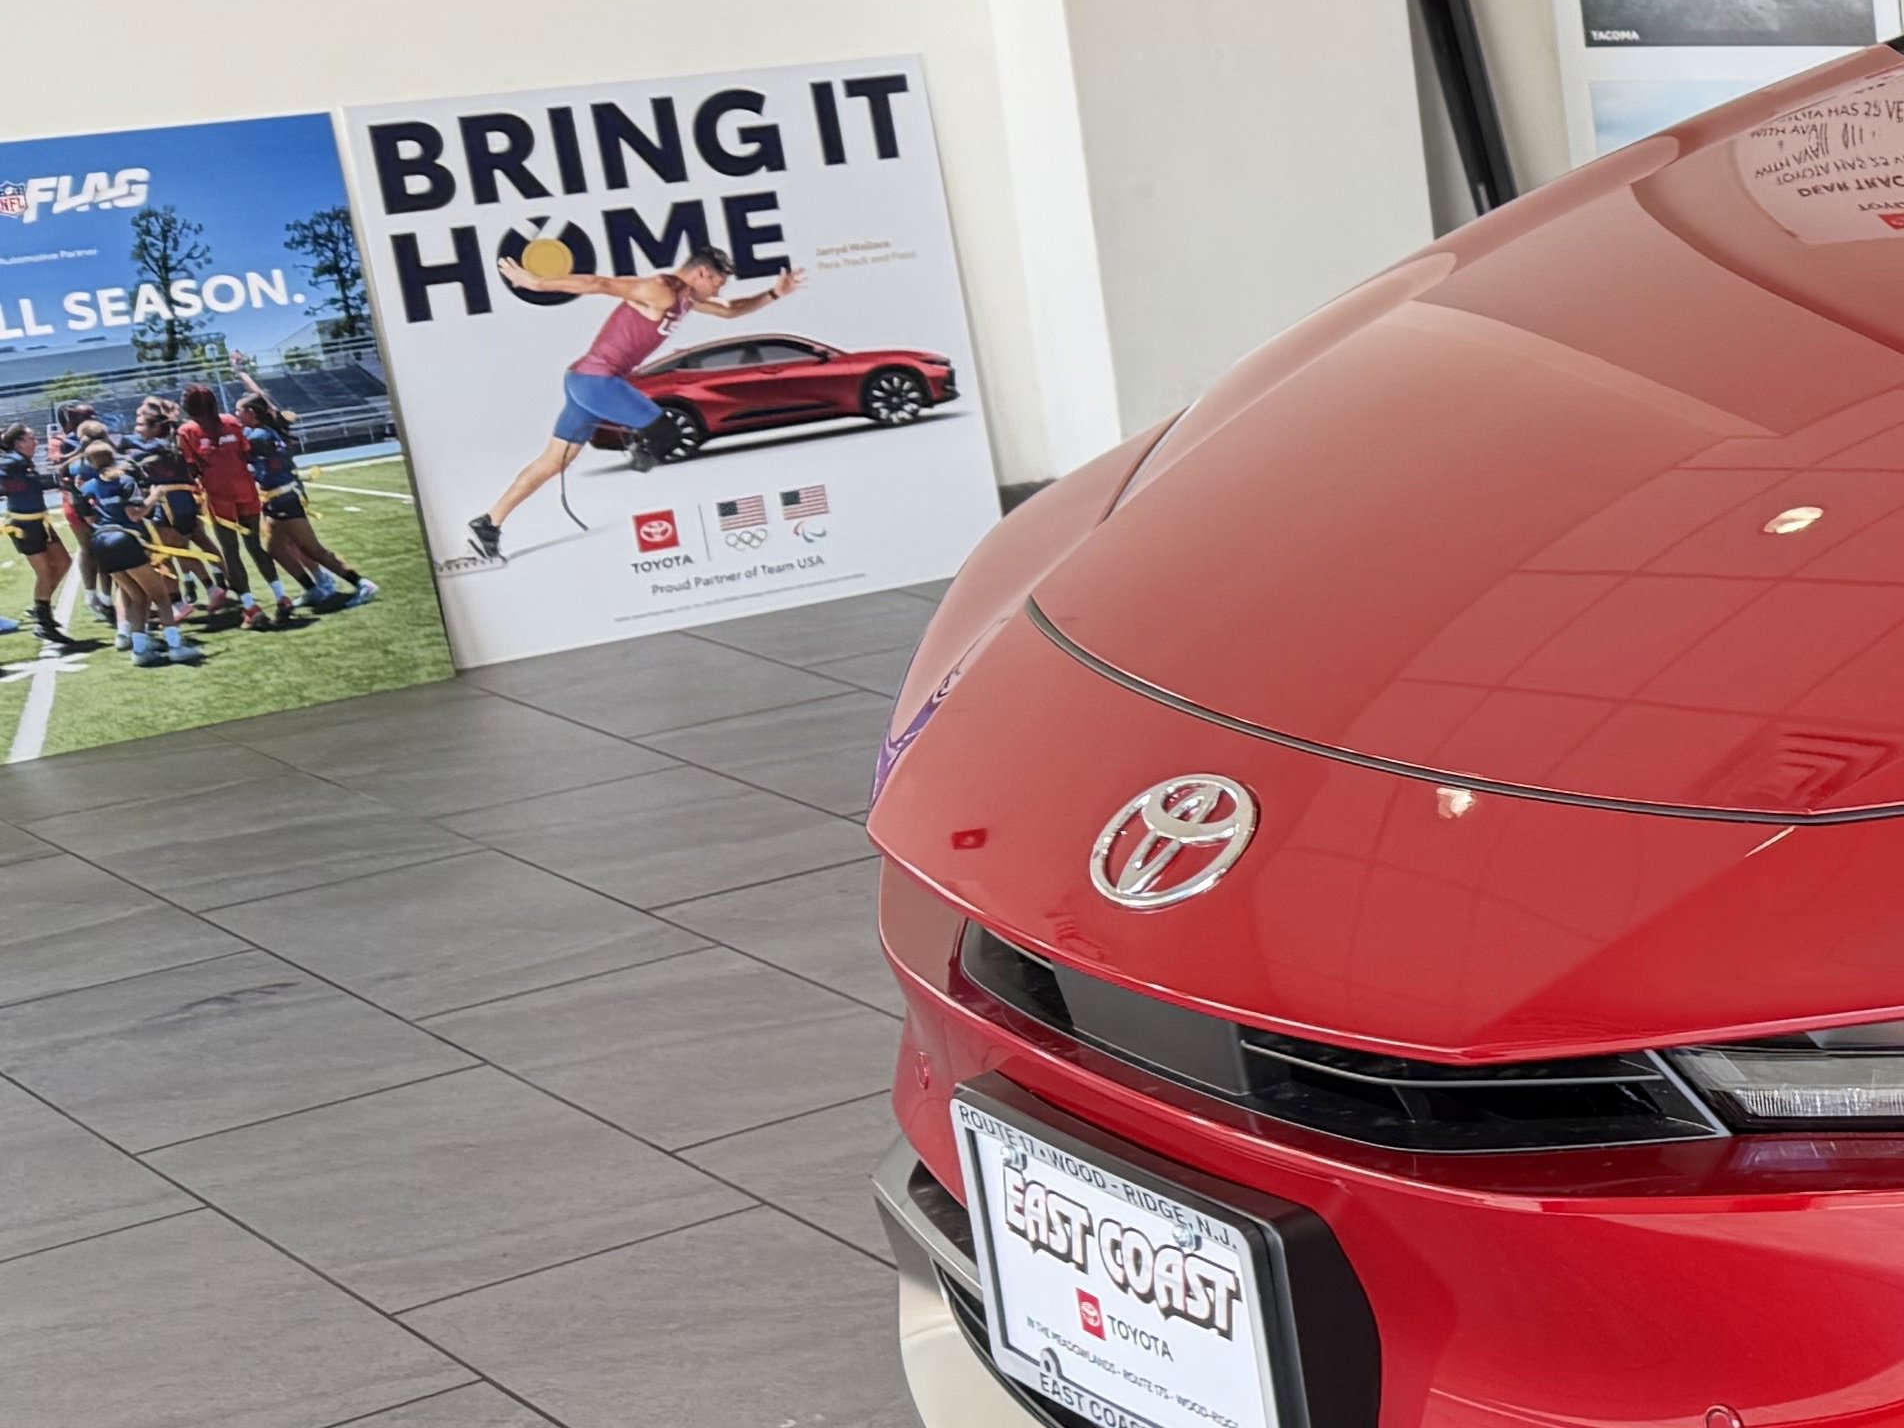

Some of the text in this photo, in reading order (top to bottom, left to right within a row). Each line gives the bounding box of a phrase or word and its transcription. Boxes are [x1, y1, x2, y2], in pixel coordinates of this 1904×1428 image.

[366, 73, 909, 217] BRING IT
[23, 167, 150, 223] FLAG
[389, 191, 792, 324] HOME
[63, 269, 306, 331] SEASON.
[631, 554, 695, 575] TOYOTA
[651, 554, 826, 596] Proud Partner of Team USA
[959, 1105, 1016, 1146] ROUTE
[1020, 1135, 1035, 1153] 17
[1048, 1149, 1107, 1189] WOOD
[1003, 1164, 1244, 1341] EAST COAST
[1107, 1314, 1174, 1362] TOYOTA
[1039, 1372, 1085, 1412] EAST
